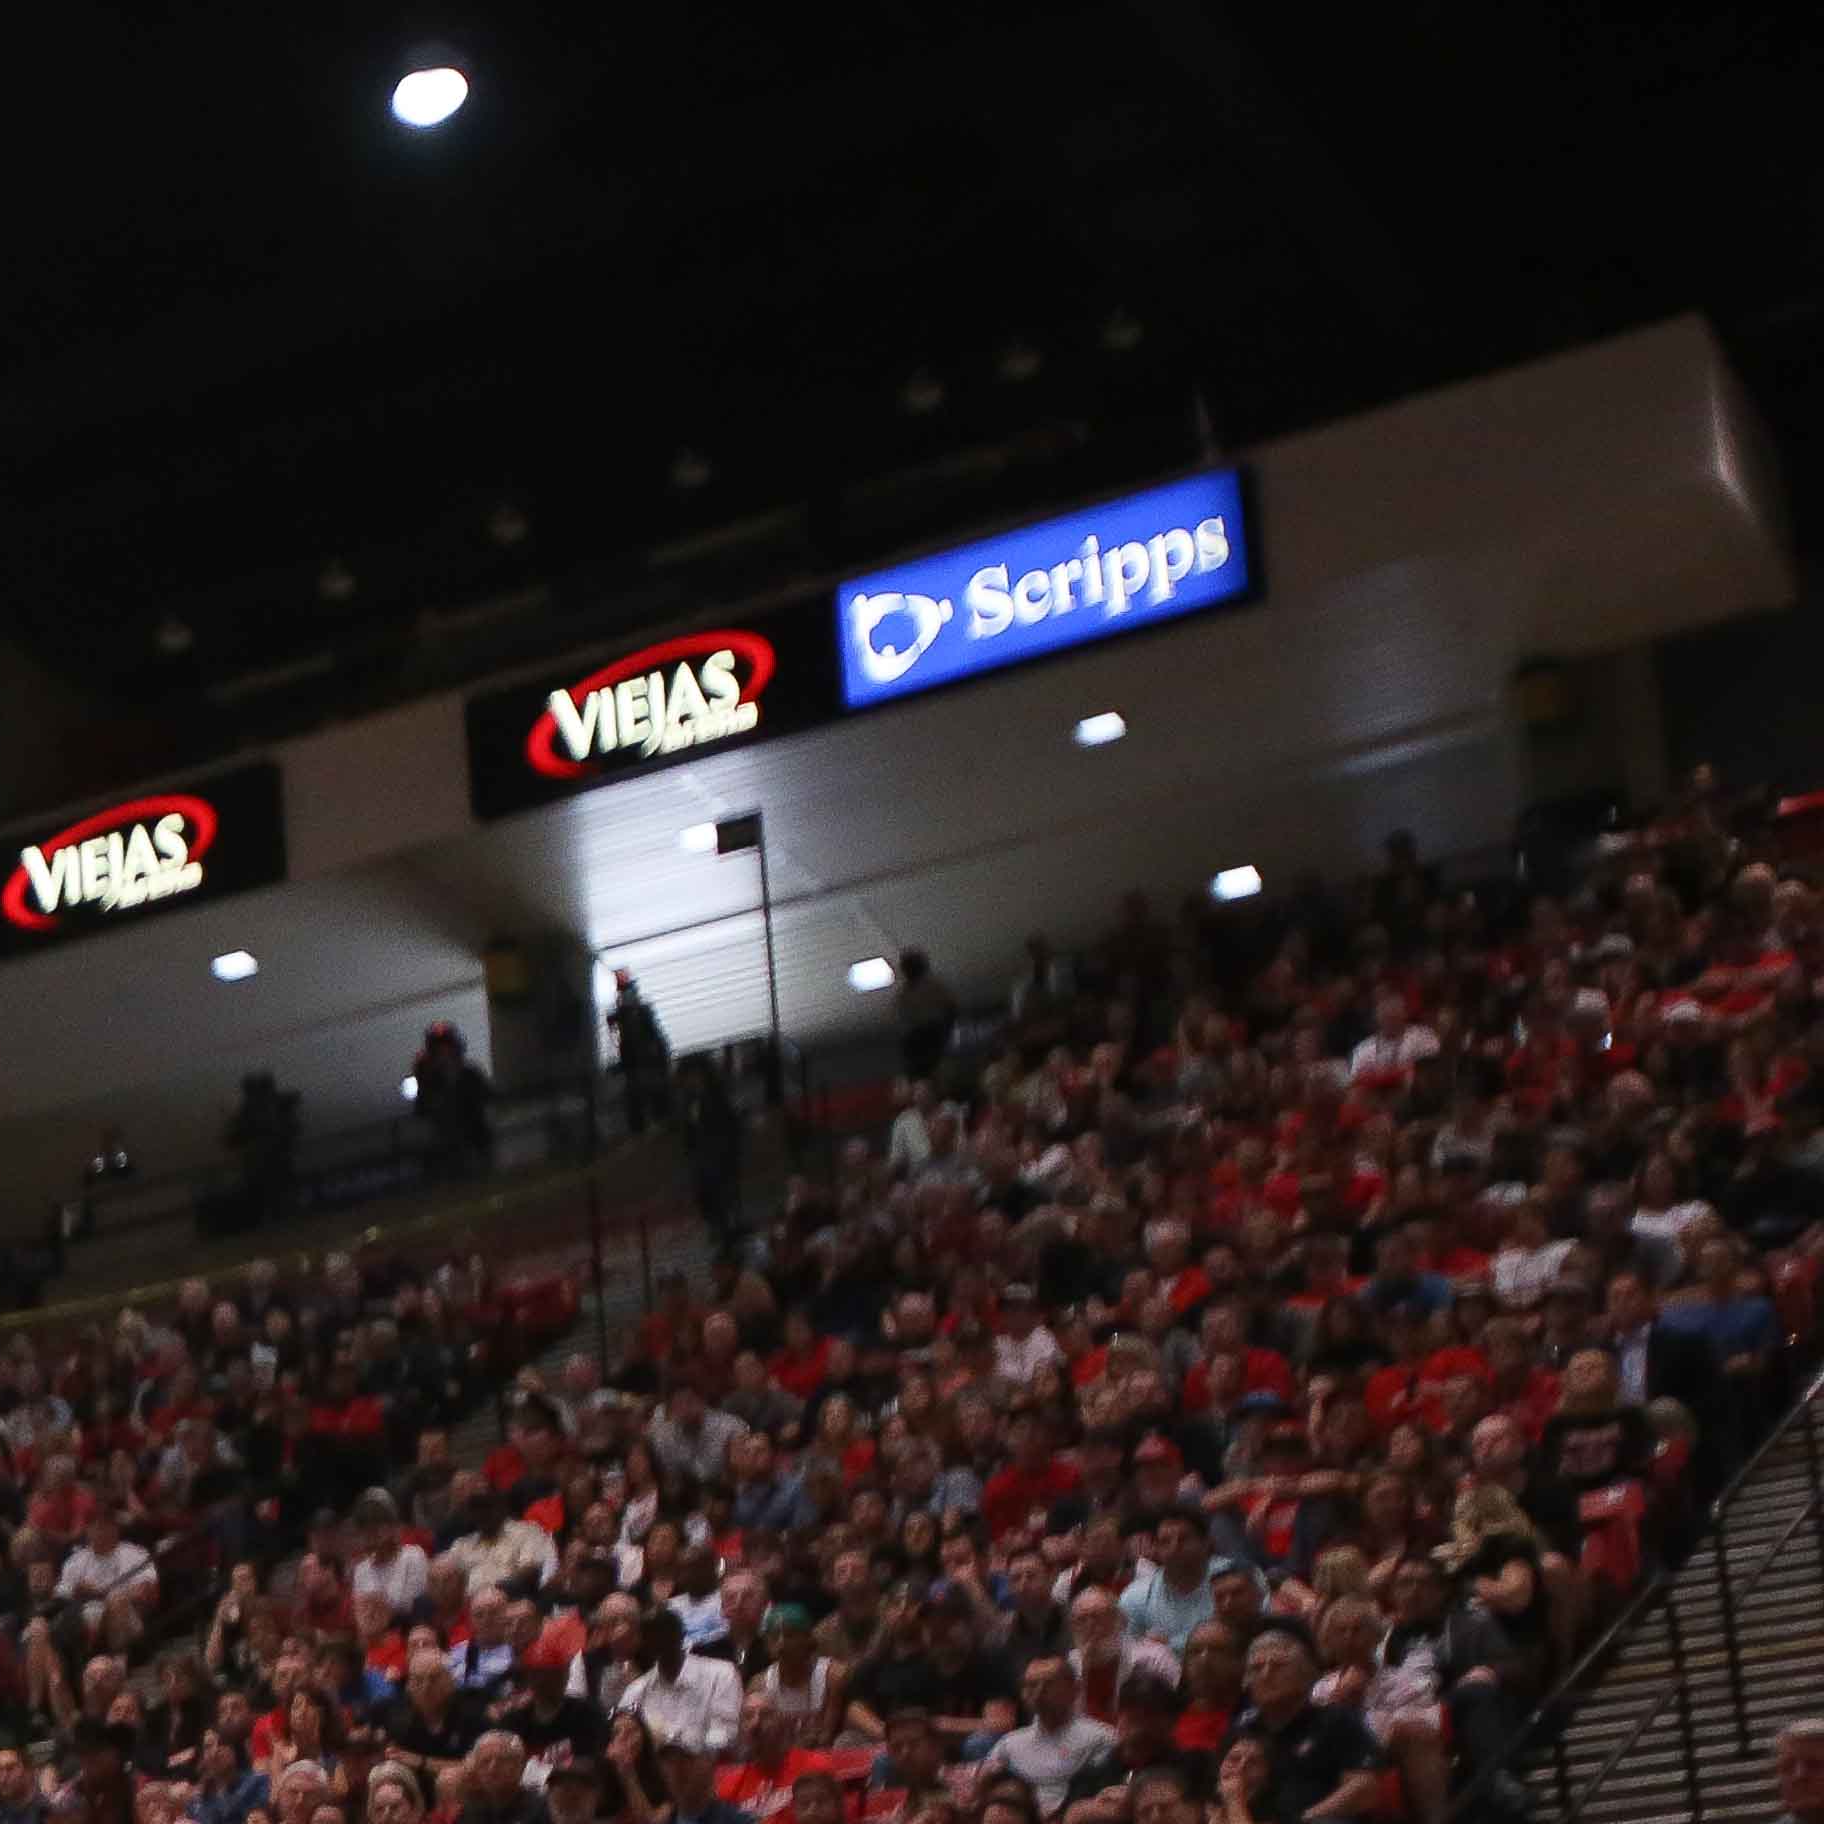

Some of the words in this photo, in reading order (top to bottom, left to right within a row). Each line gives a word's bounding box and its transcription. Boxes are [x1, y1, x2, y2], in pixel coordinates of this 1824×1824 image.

[963, 514, 1232, 640] Scripps
[549, 650, 742, 761] VIEJAS
[20, 813, 189, 914] VIEJAS
